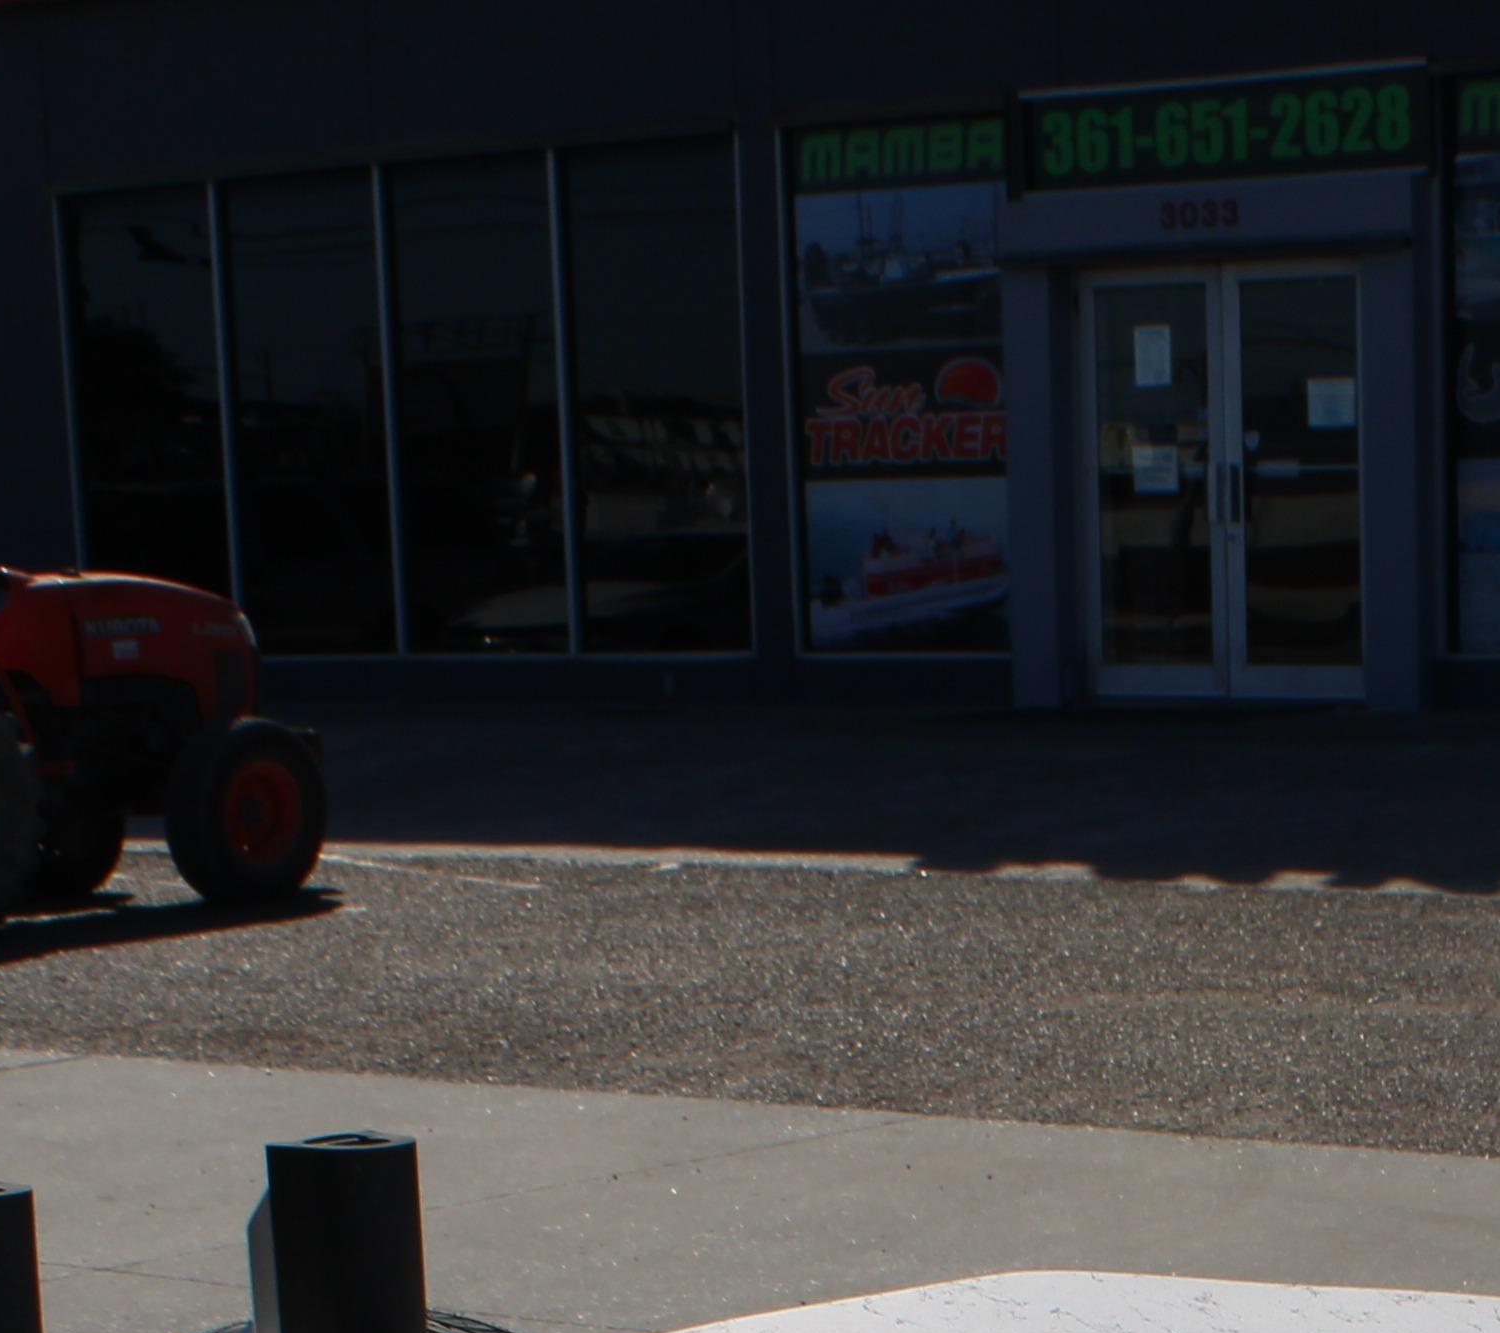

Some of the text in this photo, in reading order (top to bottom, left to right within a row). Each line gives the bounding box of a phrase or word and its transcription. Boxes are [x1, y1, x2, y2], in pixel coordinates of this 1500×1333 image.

[803, 117, 1003, 181] MAMBA
[1042, 83, 1412, 176] 361-651-2628
[1161, 200, 1240, 229] 3033
